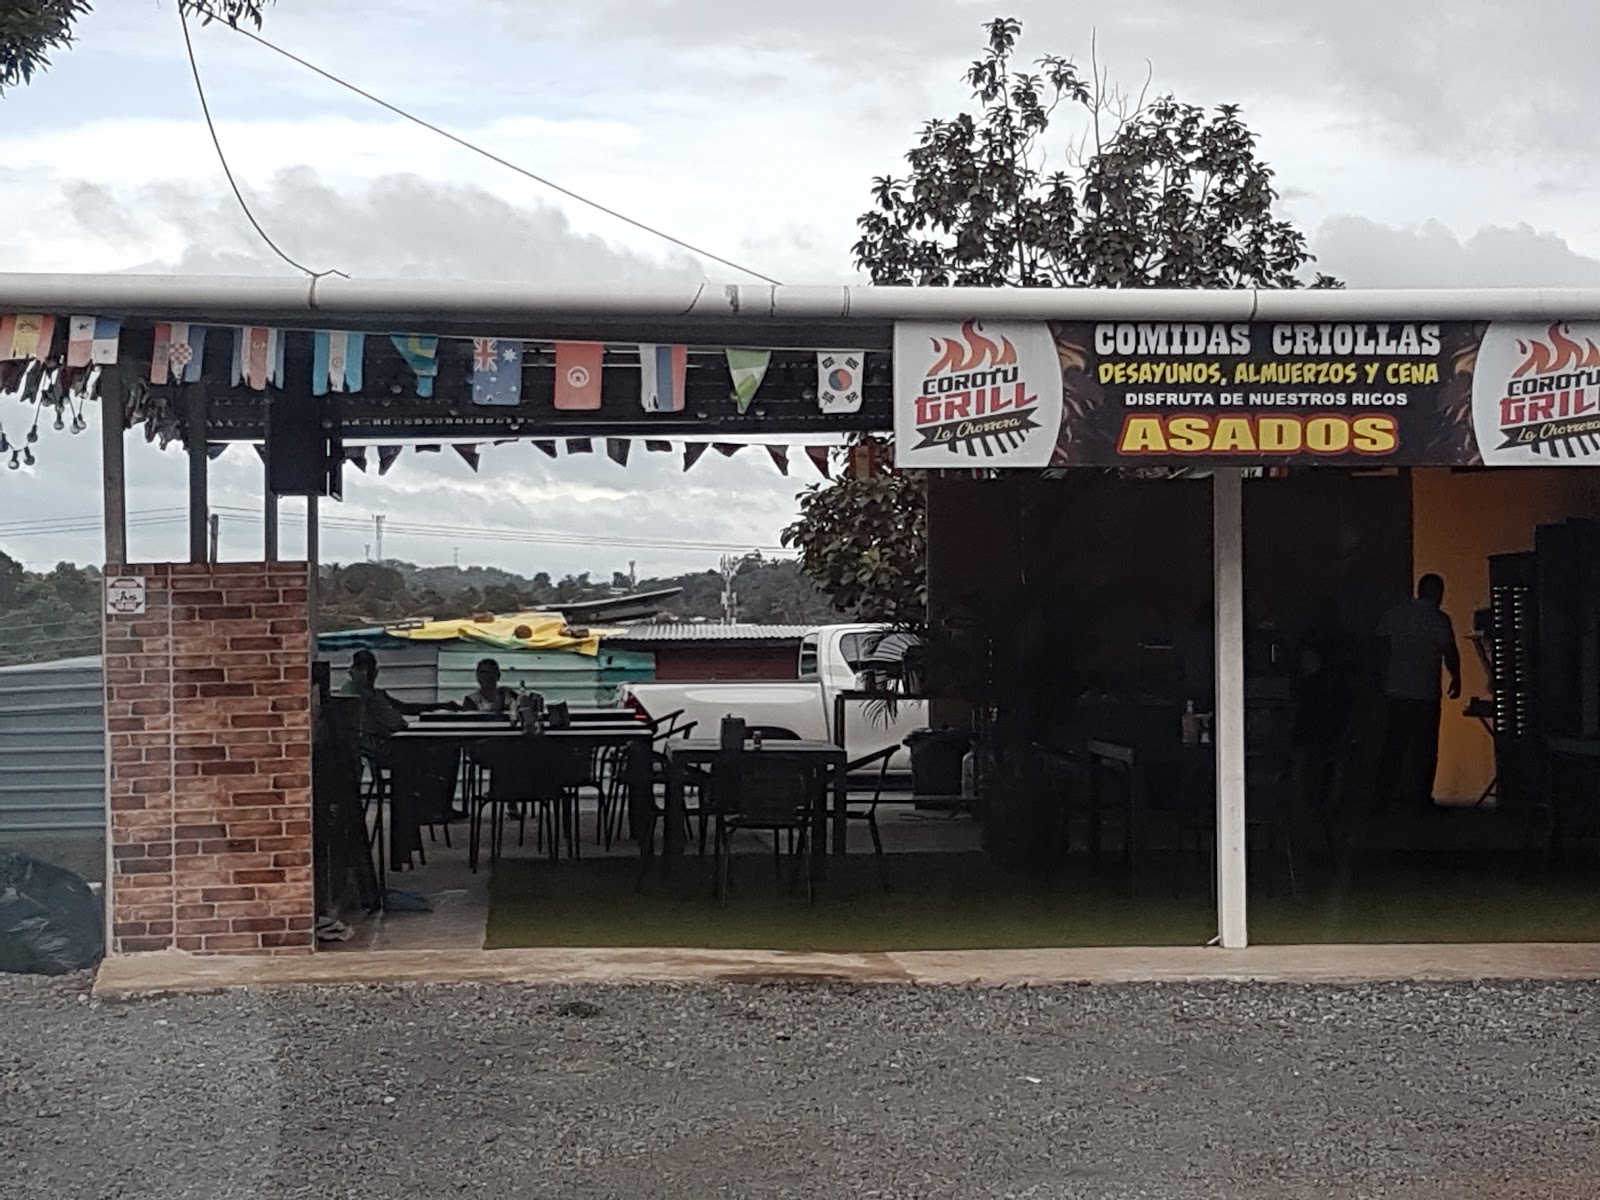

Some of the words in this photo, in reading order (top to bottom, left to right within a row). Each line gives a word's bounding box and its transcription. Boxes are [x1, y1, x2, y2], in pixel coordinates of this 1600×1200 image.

[1094, 324, 1250, 356] COMIDAS
[1272, 324, 1441, 356] CRIOLLAS
[922, 366, 1019, 395] COROTU
[1099, 362, 1227, 386] DESAYUNOS,
[1234, 362, 1358, 385] ALMUERZOS
[1365, 363, 1379, 384] Y
[1386, 363, 1440, 384] CENA
[914, 382, 1038, 425] GRILL
[1125, 393, 1213, 406] DISFRUTA
[1219, 393, 1244, 406] DE
[1249, 393, 1347, 406] NUESTROS
[1352, 393, 1408, 406] RICOS
[1499, 387, 1600, 426] GRIL
[932, 427, 953, 442] La
[956, 417, 1022, 438] Chorrera
[1121, 417, 1397, 452] ASADOS
[1517, 428, 1537, 442] La
